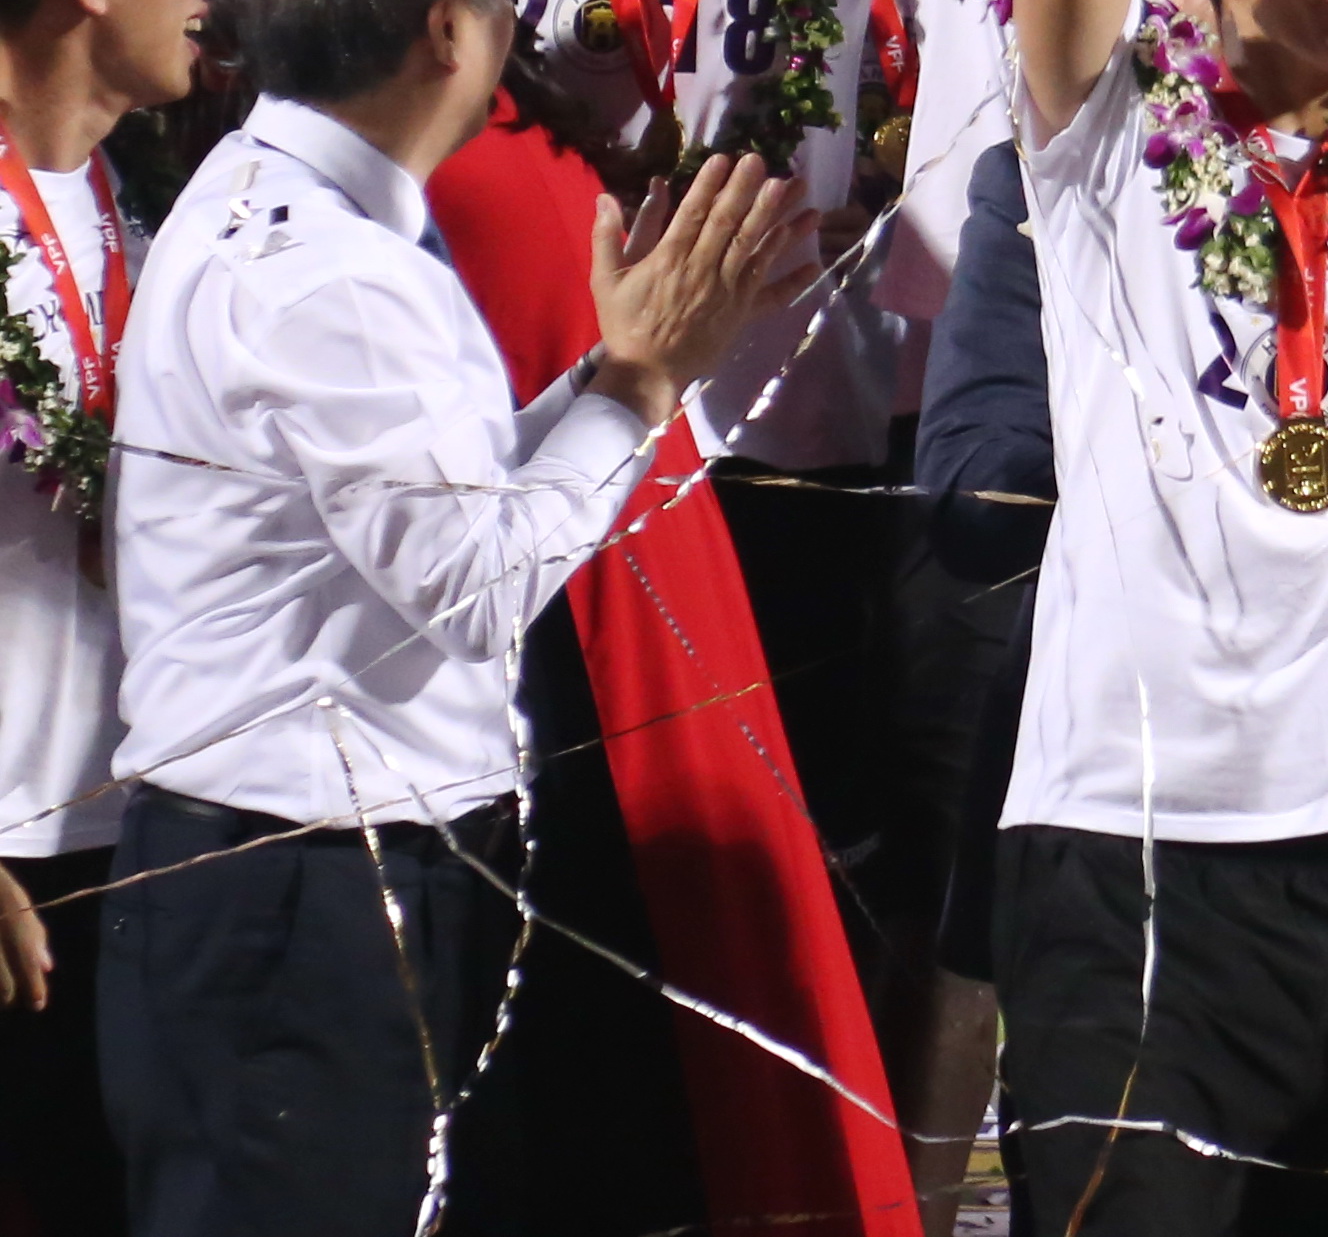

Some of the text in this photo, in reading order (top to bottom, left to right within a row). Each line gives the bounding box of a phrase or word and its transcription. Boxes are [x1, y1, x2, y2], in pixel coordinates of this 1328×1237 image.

[40, 232, 68, 275] VPF
[101, 212, 122, 253] VPF
[82, 356, 102, 401] VPF
